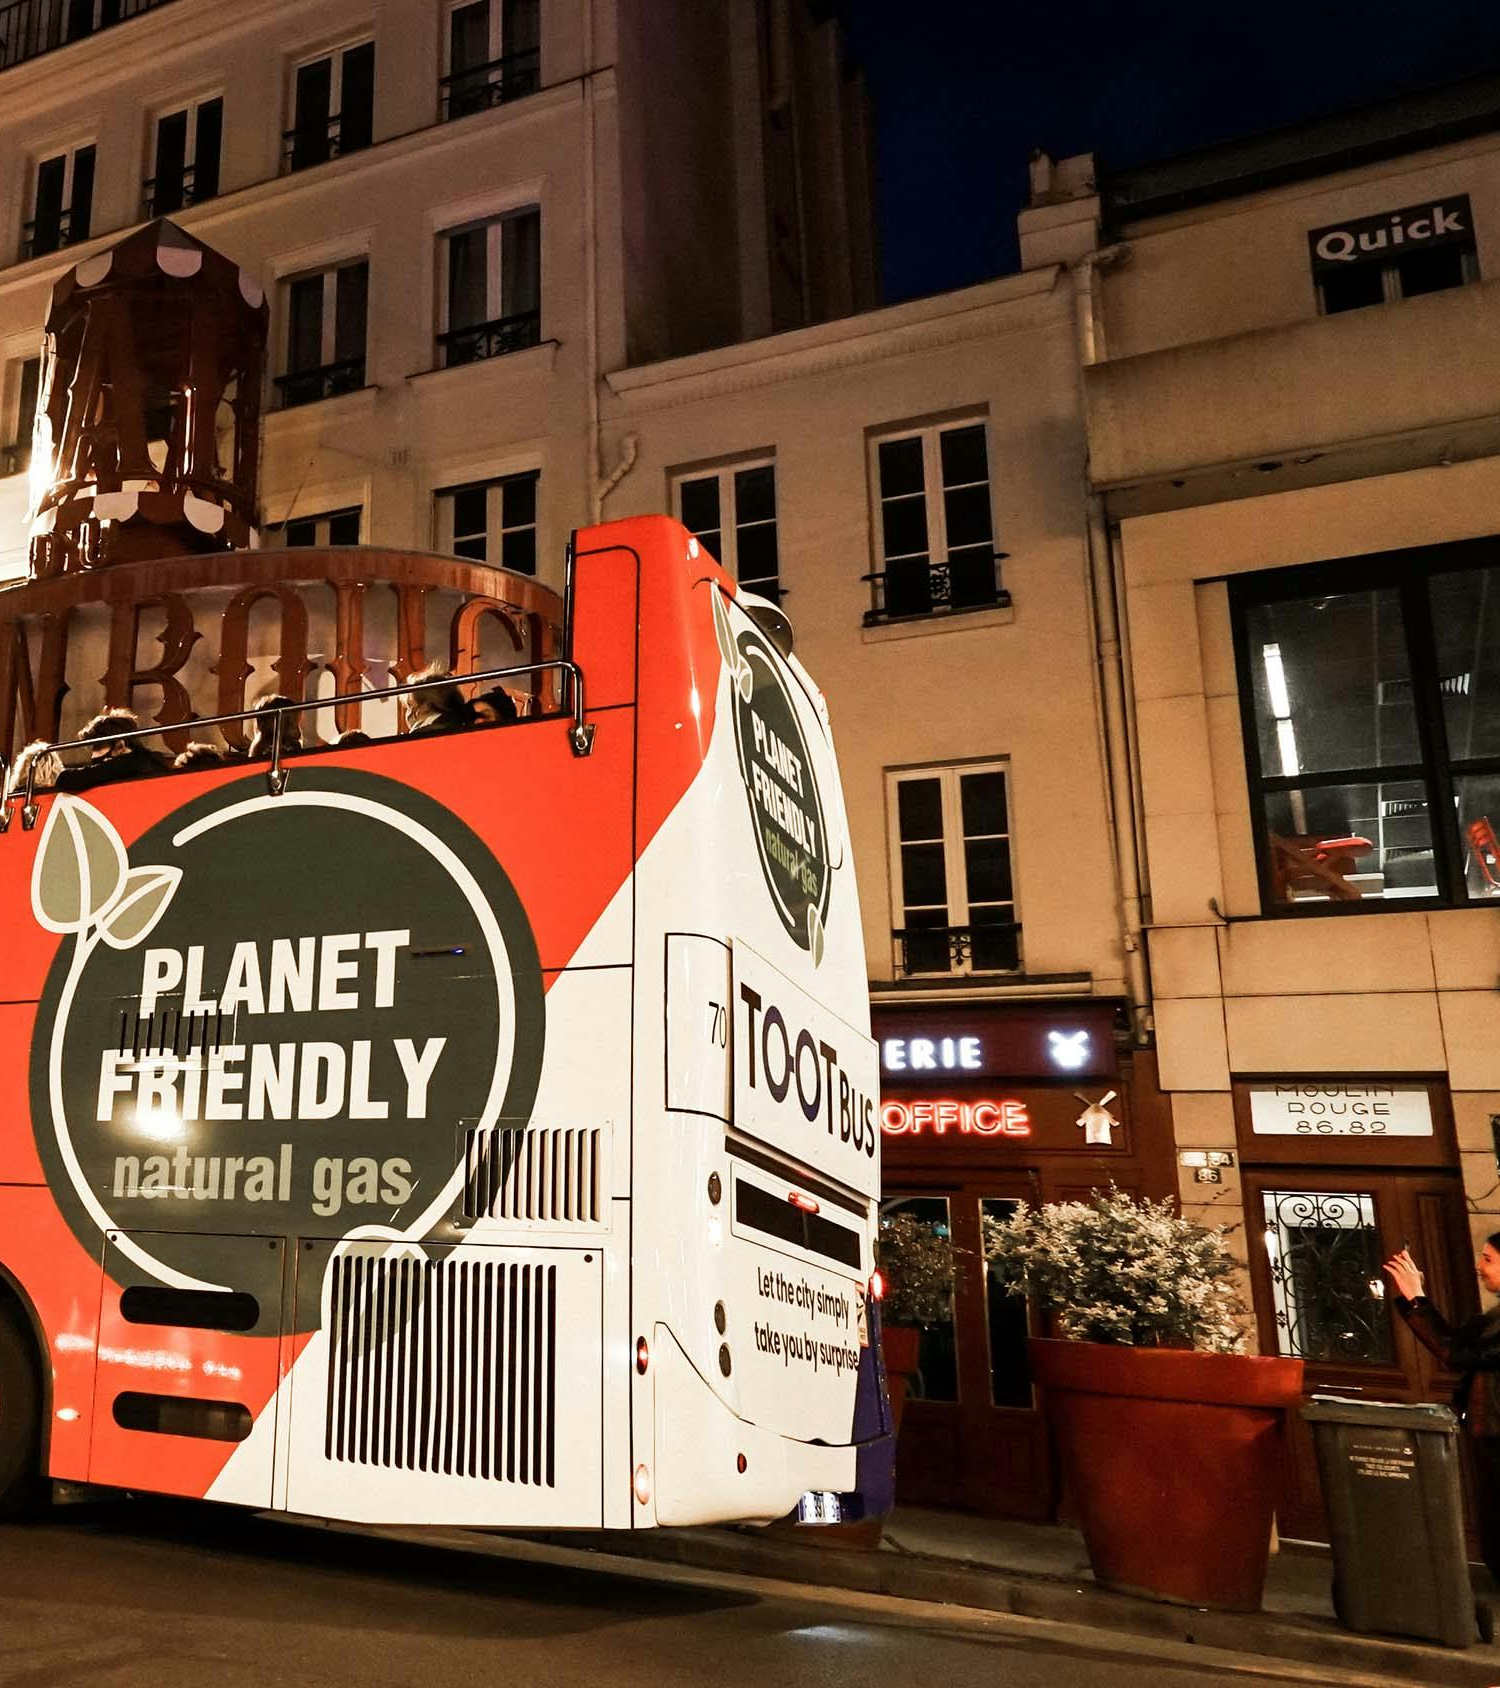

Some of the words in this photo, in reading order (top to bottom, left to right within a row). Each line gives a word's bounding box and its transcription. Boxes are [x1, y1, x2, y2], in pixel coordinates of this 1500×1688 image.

[1316, 206, 1465, 261] Quick
[751, 710, 804, 798] PLANET
[751, 760, 817, 858] FRIENDLY
[765, 827, 800, 881] natural
[801, 854, 818, 897] gas
[138, 929, 410, 1020] PLANET
[708, 1001, 727, 1050] 70
[96, 1037, 447, 1122] FRIENDLY
[1275, 1086, 1395, 1098] MOULIN
[880, 1102, 1030, 1135] OFFICE
[1287, 1102, 1391, 1115] ROUGE
[1296, 1121, 1388, 1134] 86.82
[112, 1144, 293, 1202] natural
[312, 1152, 413, 1217] gas
[1198, 1168, 1218, 1181] 86
[758, 1266, 775, 1299] Let
[776, 1272, 794, 1305] the
[796, 1277, 816, 1320] city
[817, 1284, 849, 1330] simply
[755, 1321, 781, 1355] take
[782, 1333, 804, 1367] you
[804, 1331, 819, 1373] by
